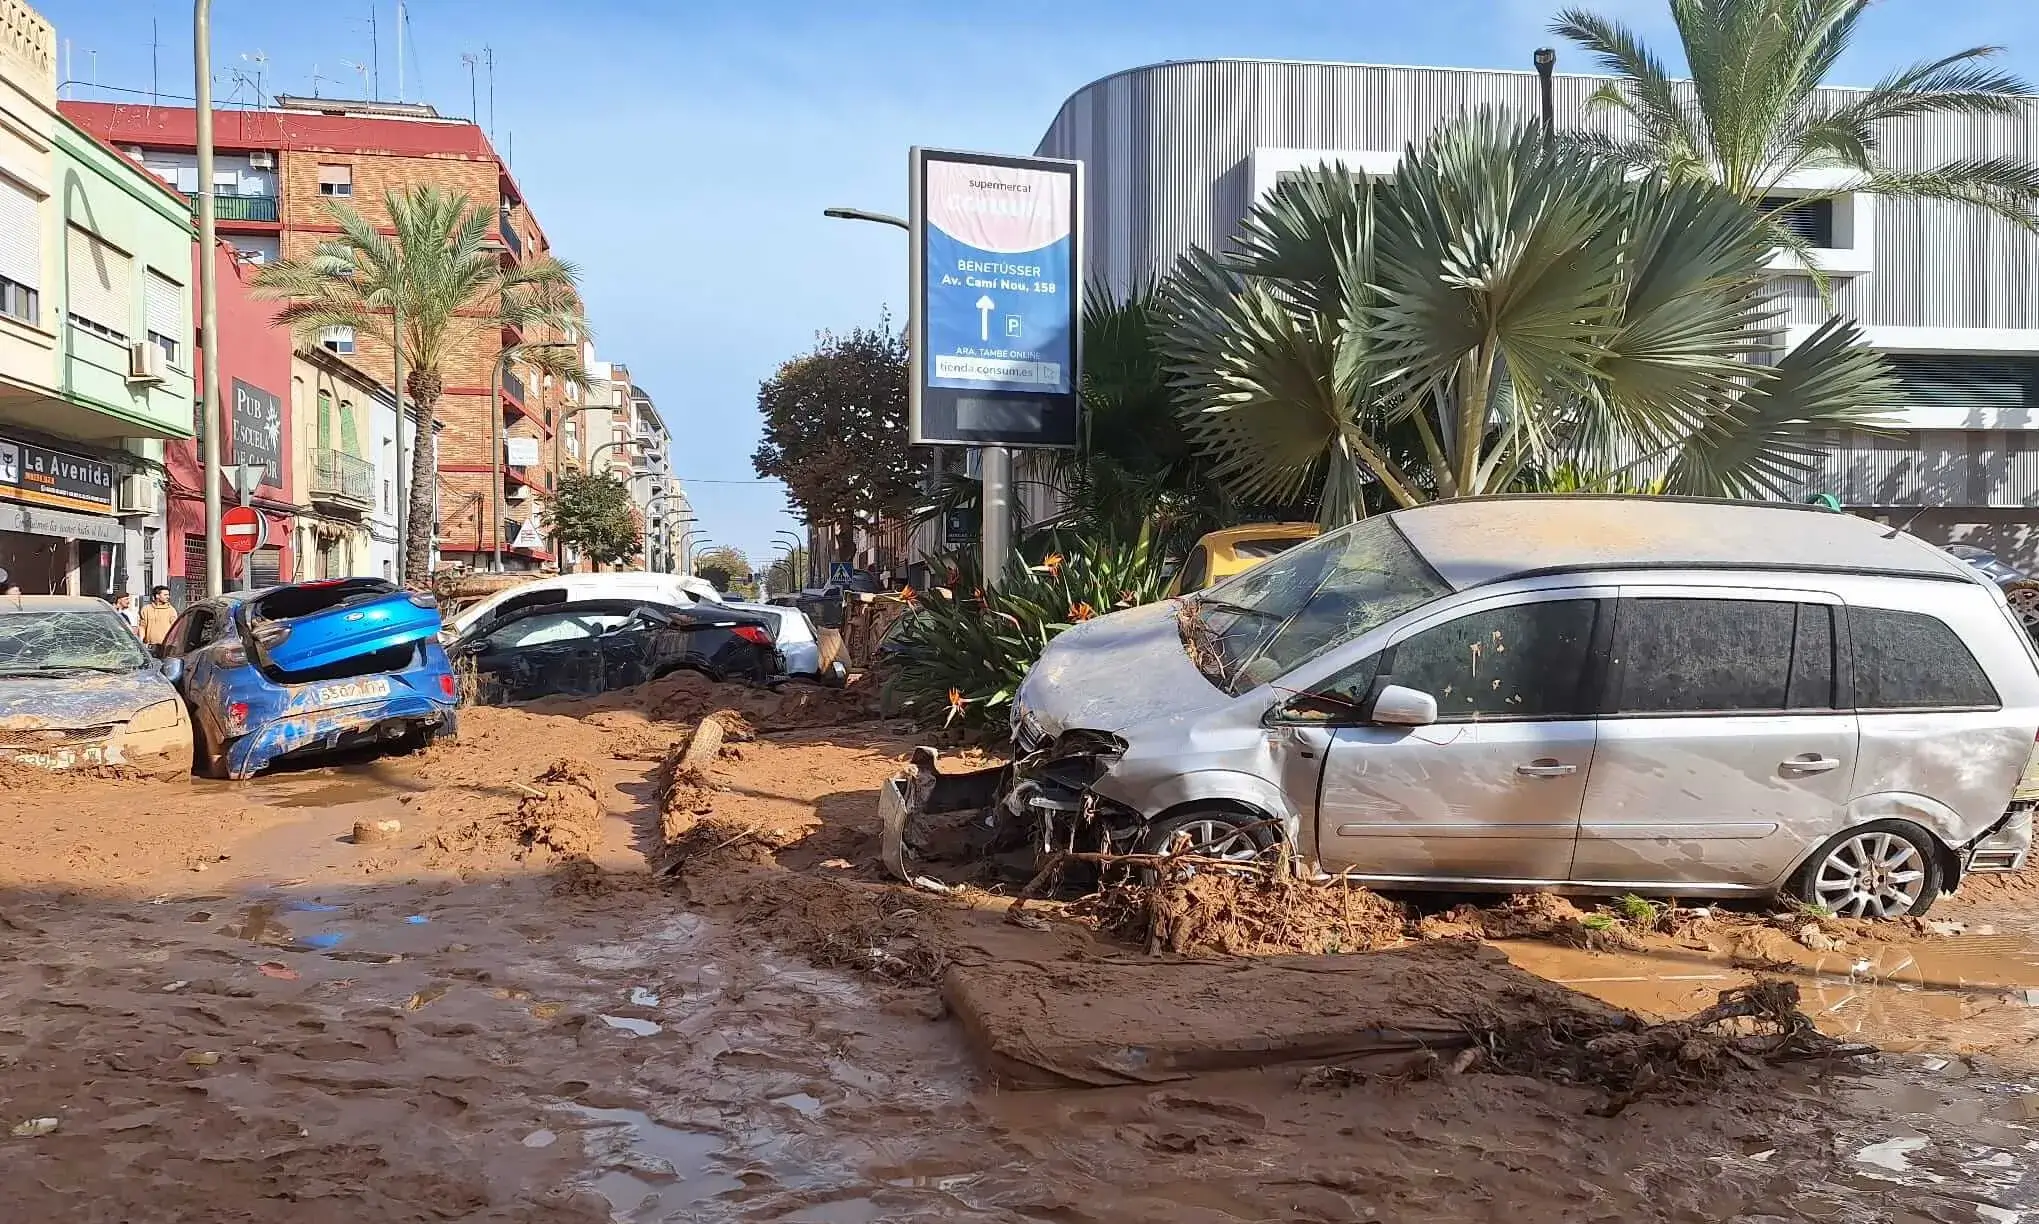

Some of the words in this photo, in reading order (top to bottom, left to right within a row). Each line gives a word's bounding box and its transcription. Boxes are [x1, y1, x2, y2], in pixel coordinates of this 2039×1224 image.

[969, 179, 1031, 193] supermercat
[942, 274, 961, 286] Av.
[966, 277, 997, 289] Camí
[1001, 279, 1029, 293] Nou,
[1034, 282, 1056, 294] 158
[1009, 350, 1041, 361] ONLINE
[237, 387, 262, 419] PUB
[233, 418, 270, 451] ESCUELA
[25, 449, 44, 473] La
[50, 455, 110, 487] Avenida
